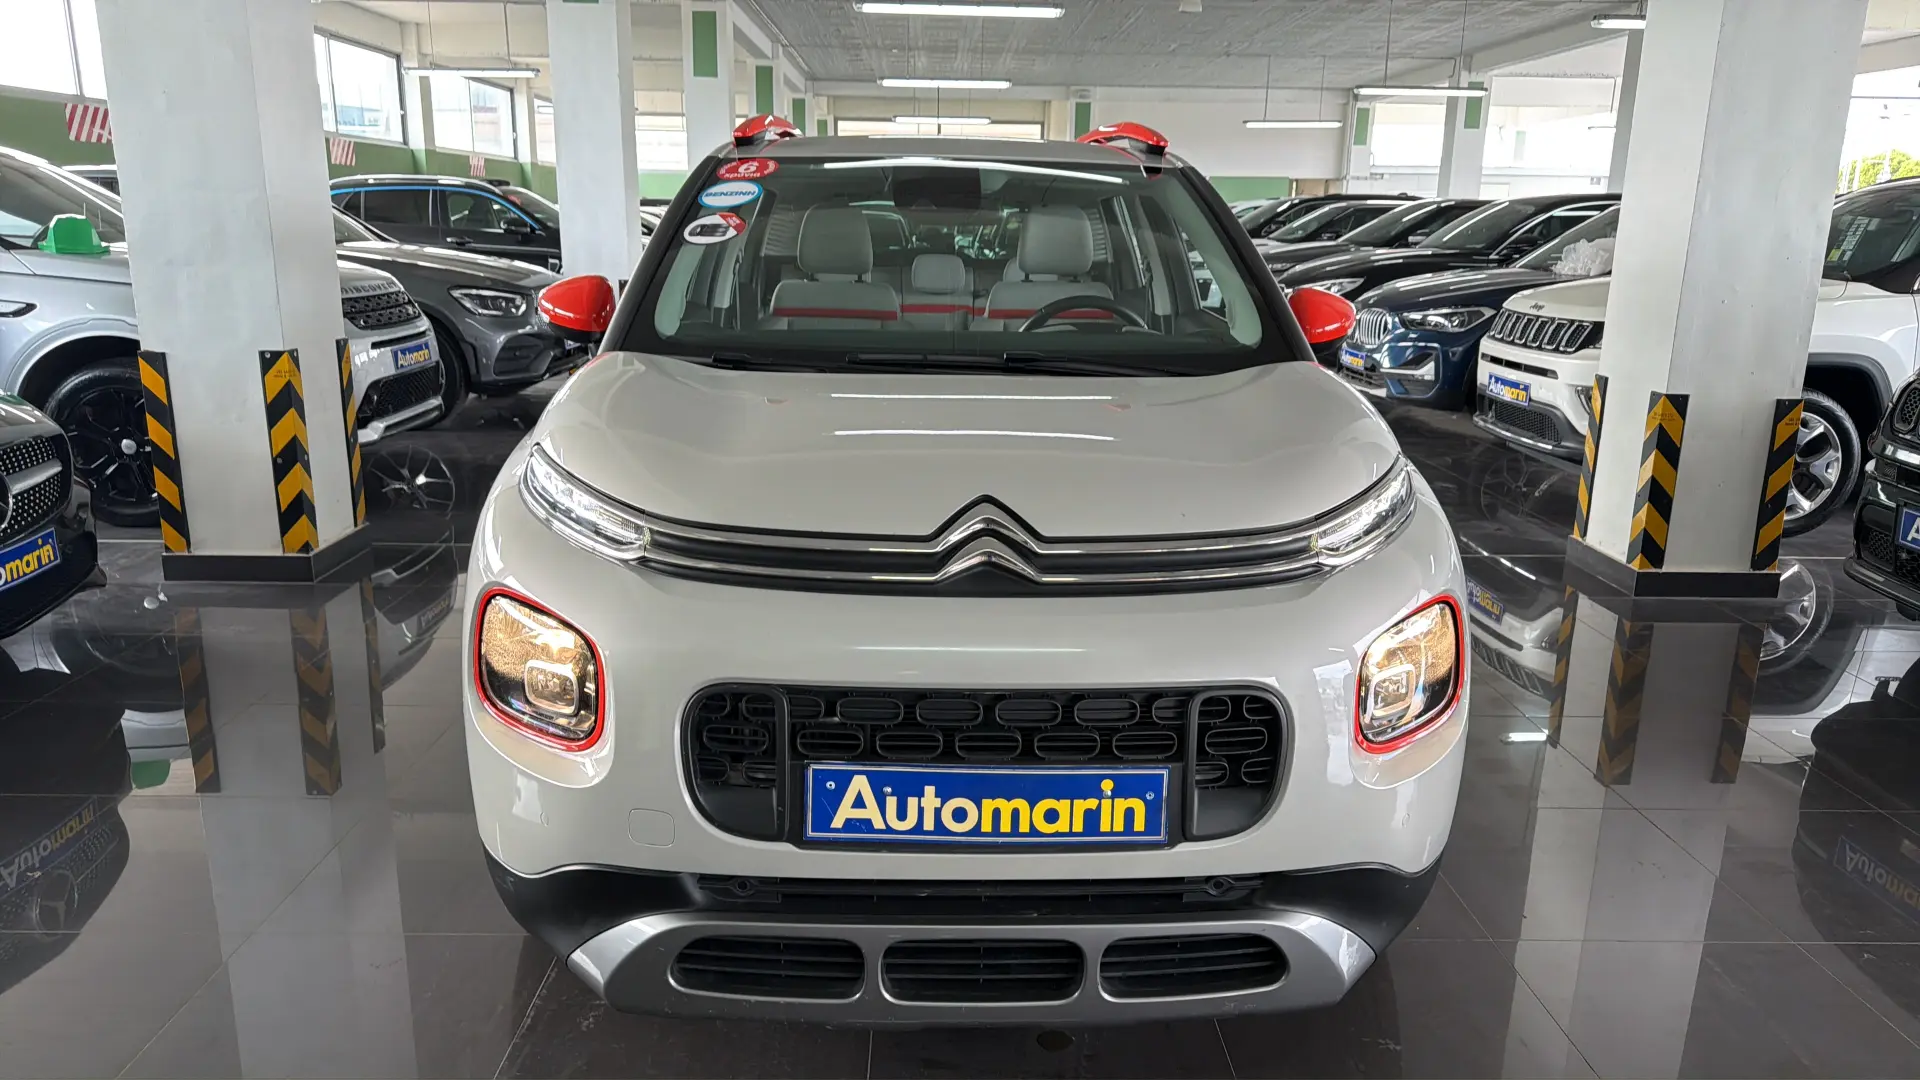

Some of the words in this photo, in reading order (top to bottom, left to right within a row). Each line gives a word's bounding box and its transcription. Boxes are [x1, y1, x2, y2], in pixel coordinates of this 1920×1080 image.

[738, 161, 759, 173] 6
[397, 343, 430, 368] Automarin
[1488, 376, 1527, 402] Automarin
[829, 774, 1146, 833] Automarin
